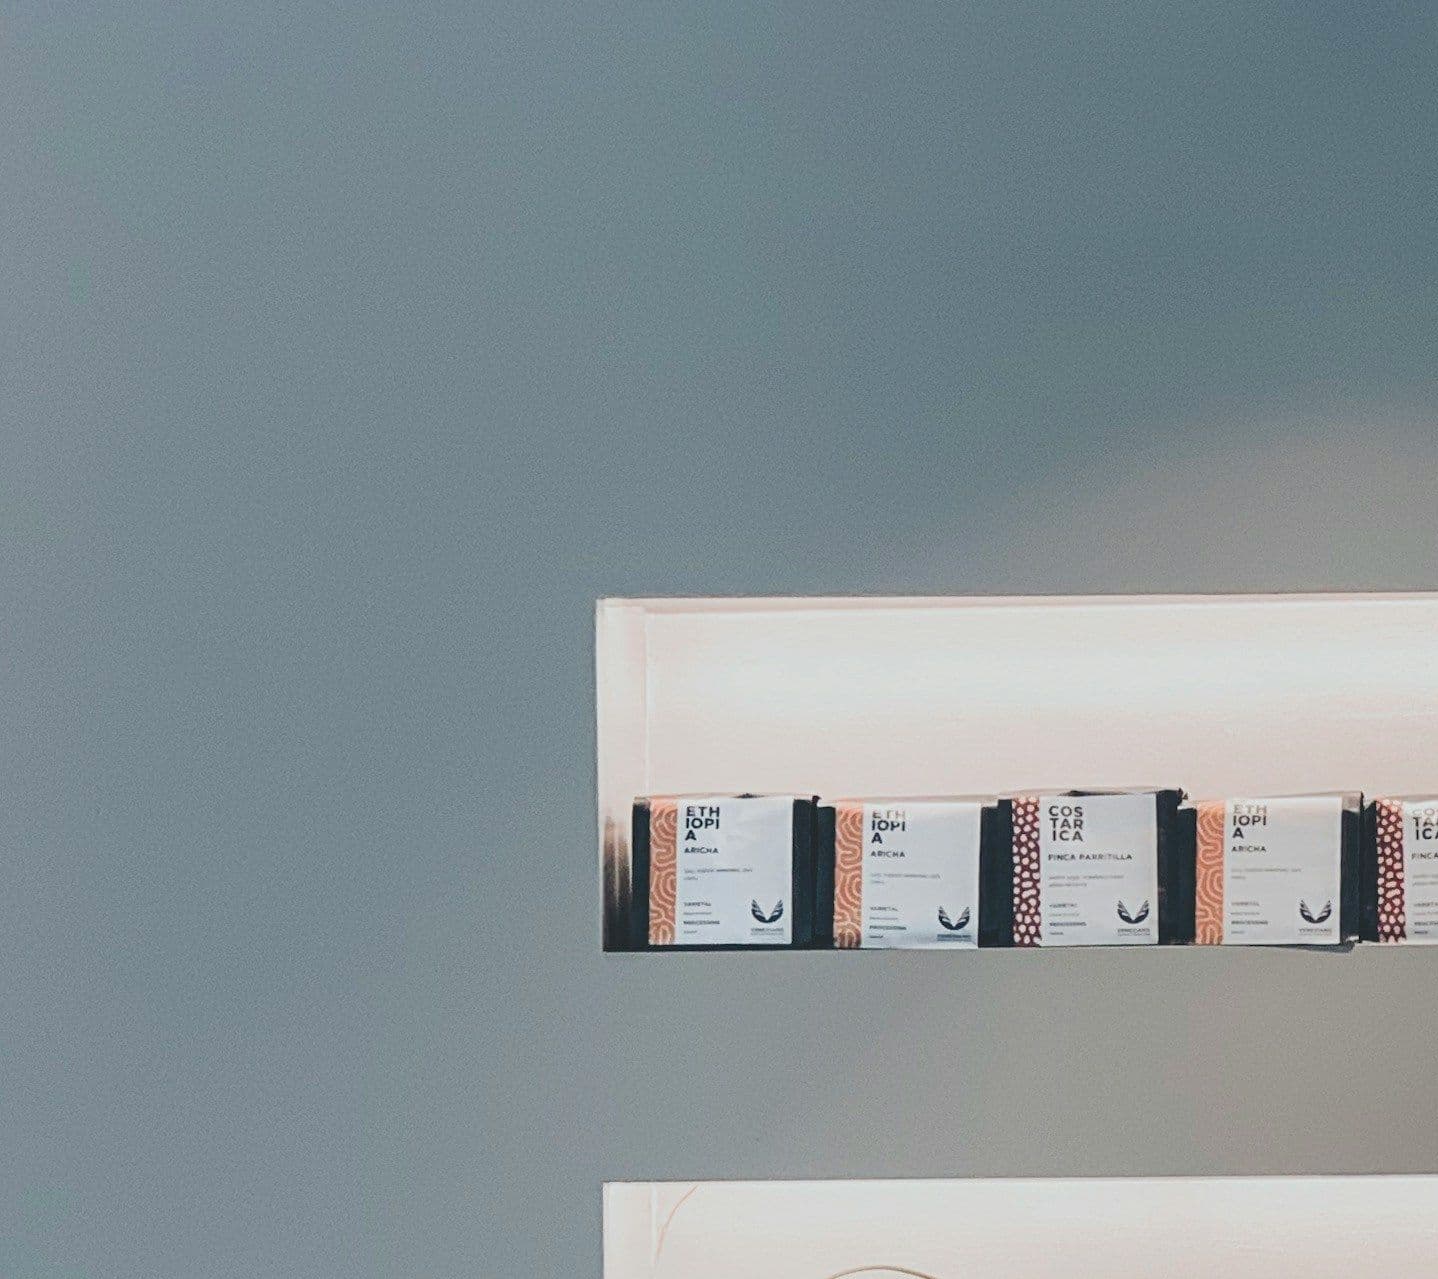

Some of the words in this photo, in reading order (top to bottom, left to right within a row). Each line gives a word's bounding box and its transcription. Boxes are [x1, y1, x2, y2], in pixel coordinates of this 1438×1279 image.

[686, 806, 720, 818] ETH
[1049, 806, 1083, 817] COS
[1234, 804, 1267, 814] ETH
[872, 810, 906, 820] ETH
[1233, 815, 1266, 826] IOPI
[686, 818, 720, 829] IOPI
[872, 820, 906, 831] IOPI
[1050, 818, 1084, 829] TAR
[685, 830, 697, 841] A
[872, 832, 883, 844] A
[1052, 830, 1084, 842] ICA
[1232, 827, 1244, 839] A
